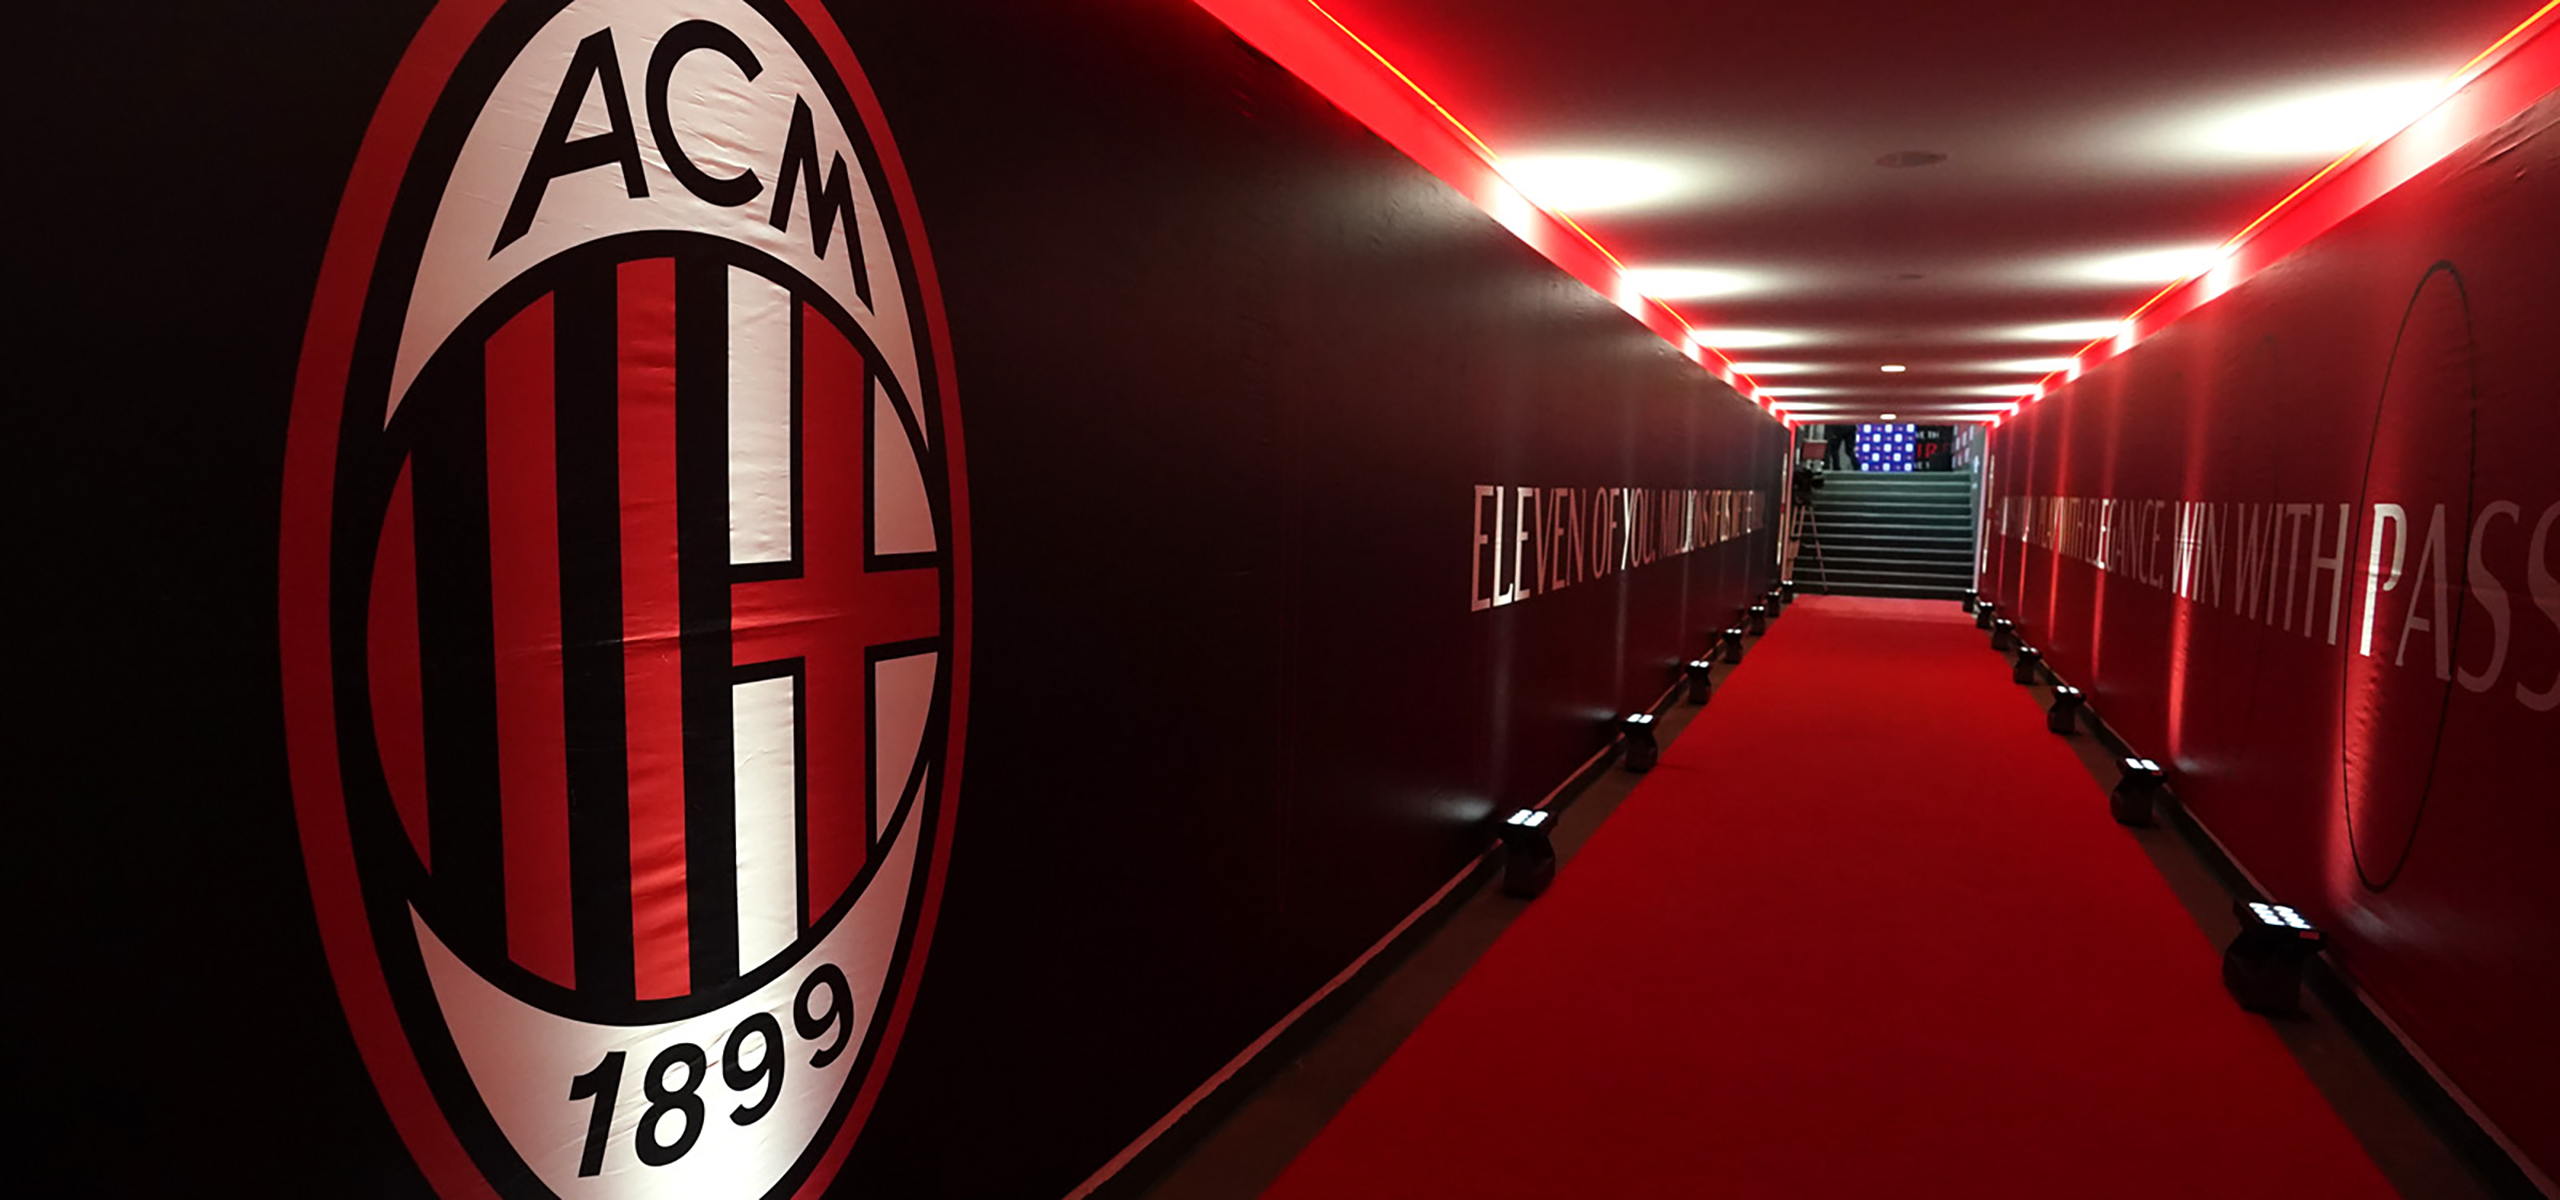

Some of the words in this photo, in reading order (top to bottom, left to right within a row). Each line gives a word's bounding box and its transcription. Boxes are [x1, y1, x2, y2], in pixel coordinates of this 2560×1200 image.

[488, 19, 875, 316] ACM
[1471, 485, 1586, 612] ELEVEN
[1593, 487, 1620, 579] OF
[2172, 501, 2228, 608] WIN
[2234, 503, 2349, 645] WITH
[568, 963, 854, 1178] 1899
